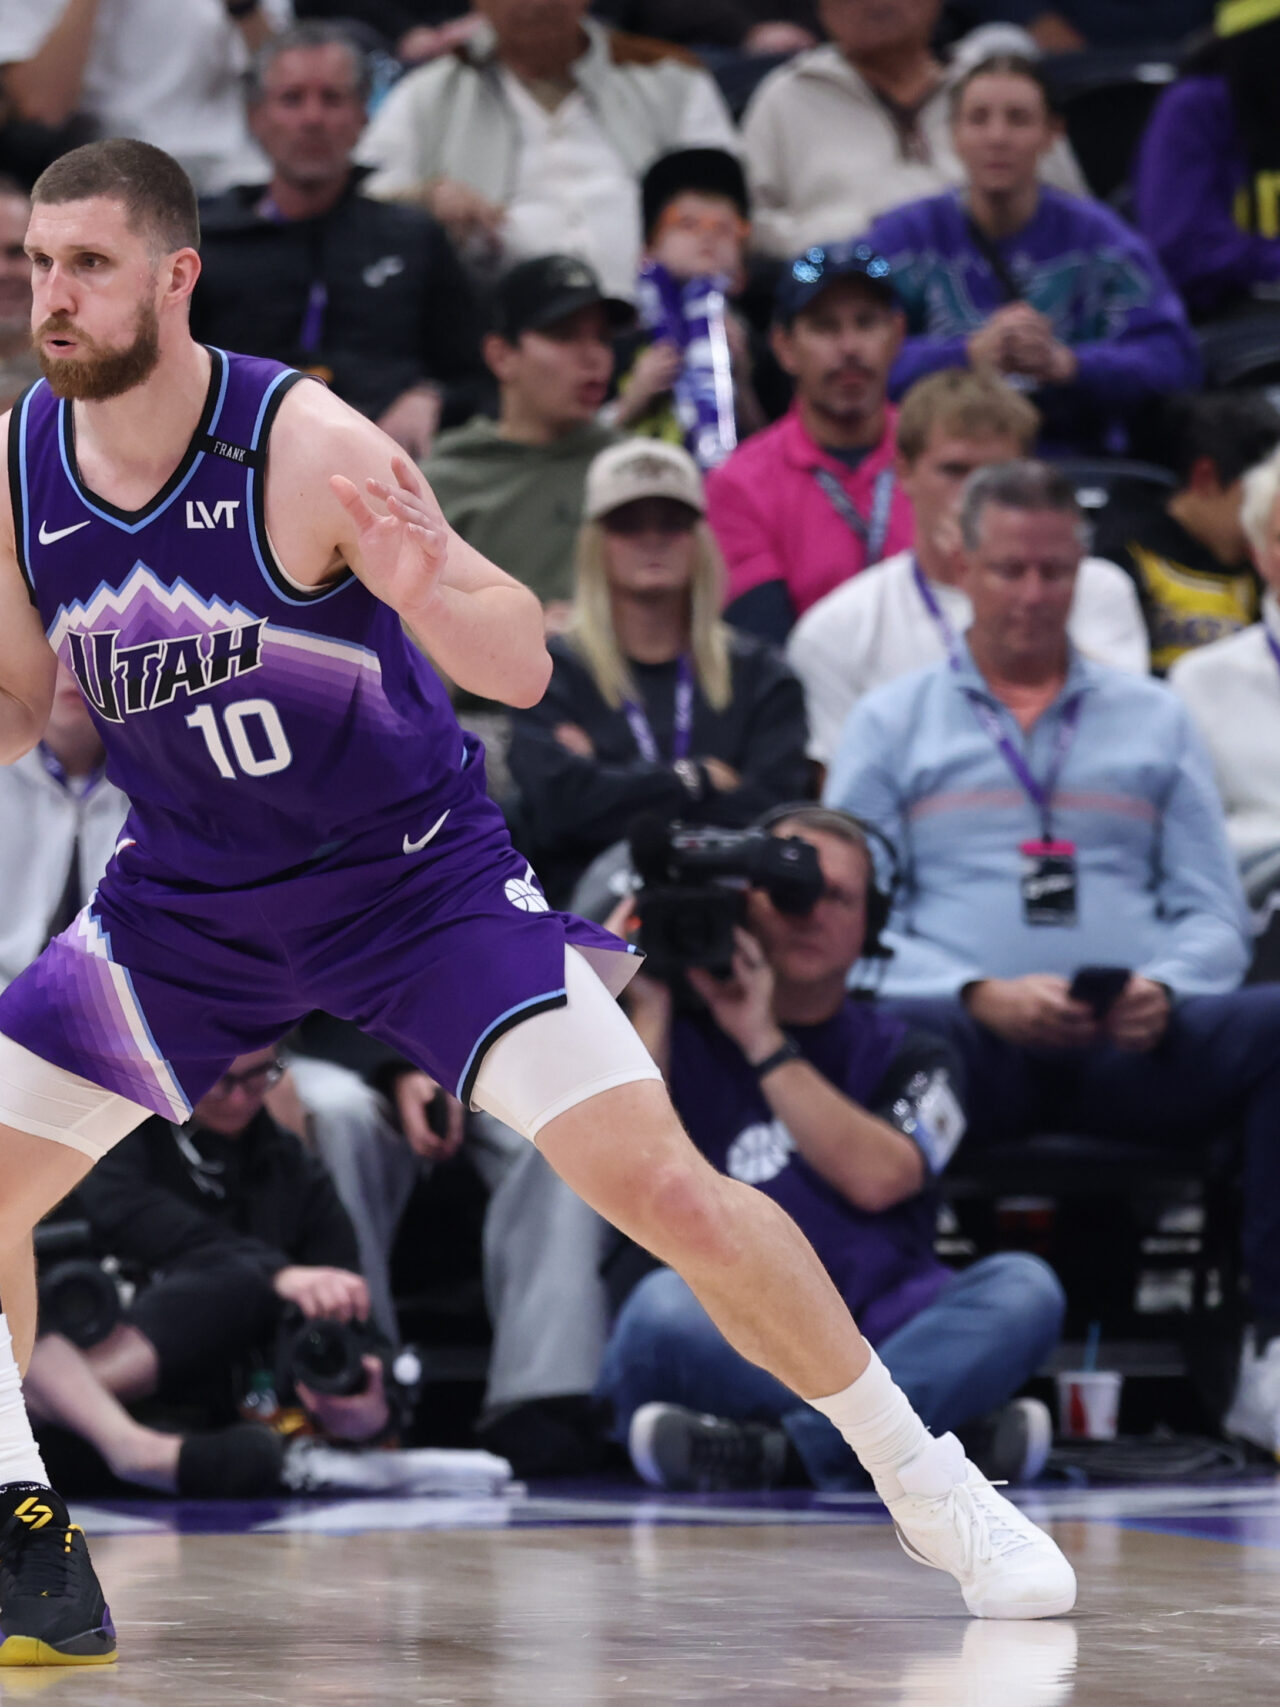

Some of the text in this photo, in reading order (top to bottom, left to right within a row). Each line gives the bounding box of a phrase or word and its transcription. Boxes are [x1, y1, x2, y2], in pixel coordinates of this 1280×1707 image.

[213, 441, 247, 463] FRANK
[186, 500, 240, 529] LVT
[65, 616, 268, 724] UTAH
[185, 698, 293, 780] 10
